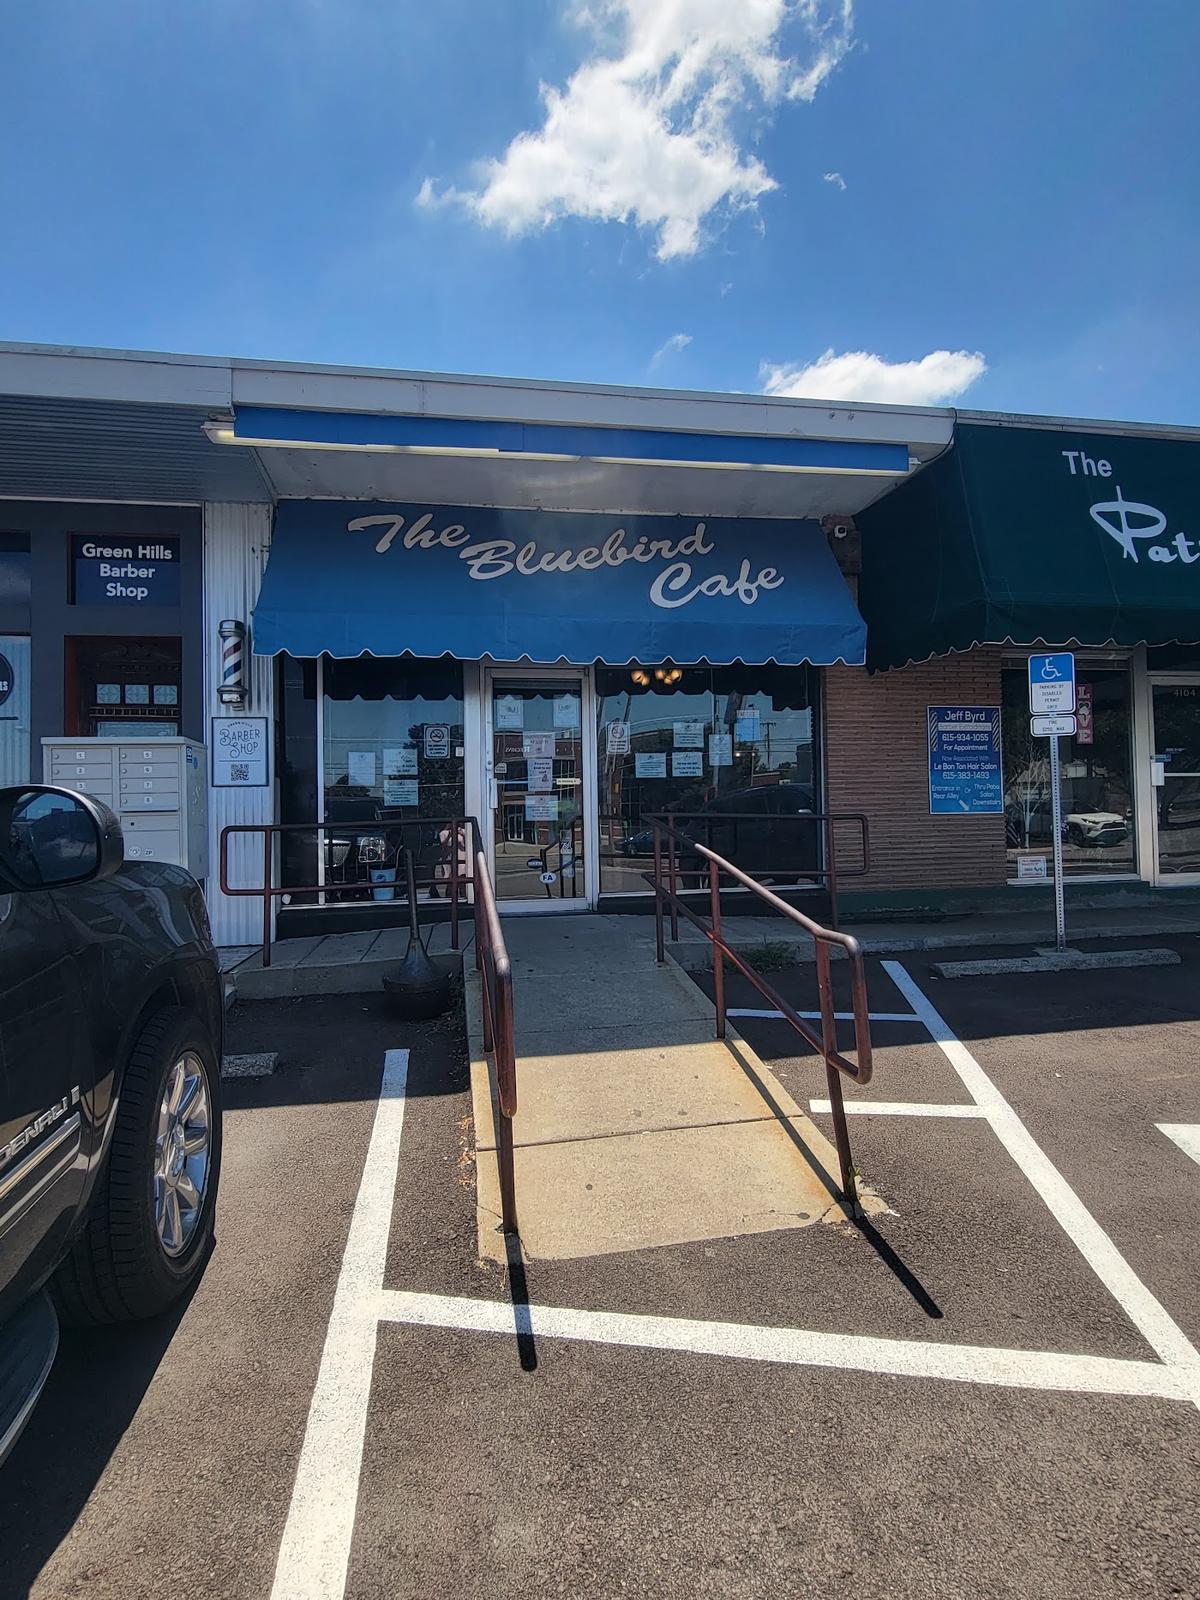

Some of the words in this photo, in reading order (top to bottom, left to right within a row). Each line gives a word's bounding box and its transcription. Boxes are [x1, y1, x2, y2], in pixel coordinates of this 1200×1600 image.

[1061, 450, 1112, 477] The
[1089, 485, 1200, 563] Pat
[81, 543, 133, 559] Green
[137, 545, 173, 560] Hills
[347, 513, 471, 554] The
[458, 522, 715, 580] Bluebird
[99, 563, 156, 578] Barber
[105, 582, 149, 601] Shop
[649, 558, 785, 609] Cafe
[1173, 689, 1196, 697] 4104
[944, 710, 964, 721] Jeff
[964, 711, 986, 725] Byrd
[219, 728, 261, 747] BARBER
[941, 733, 989, 742] 615-934-1055
[229, 741, 259, 759] SHOP
[953, 744, 988, 752] Appointment
[933, 762, 942, 770] Le
[942, 762, 955, 770] Bon
[955, 762, 967, 770] Ton
[966, 762, 980, 770] Hair
[980, 762, 998, 770] Salon
[942, 771, 990, 780] 615-383-1493
